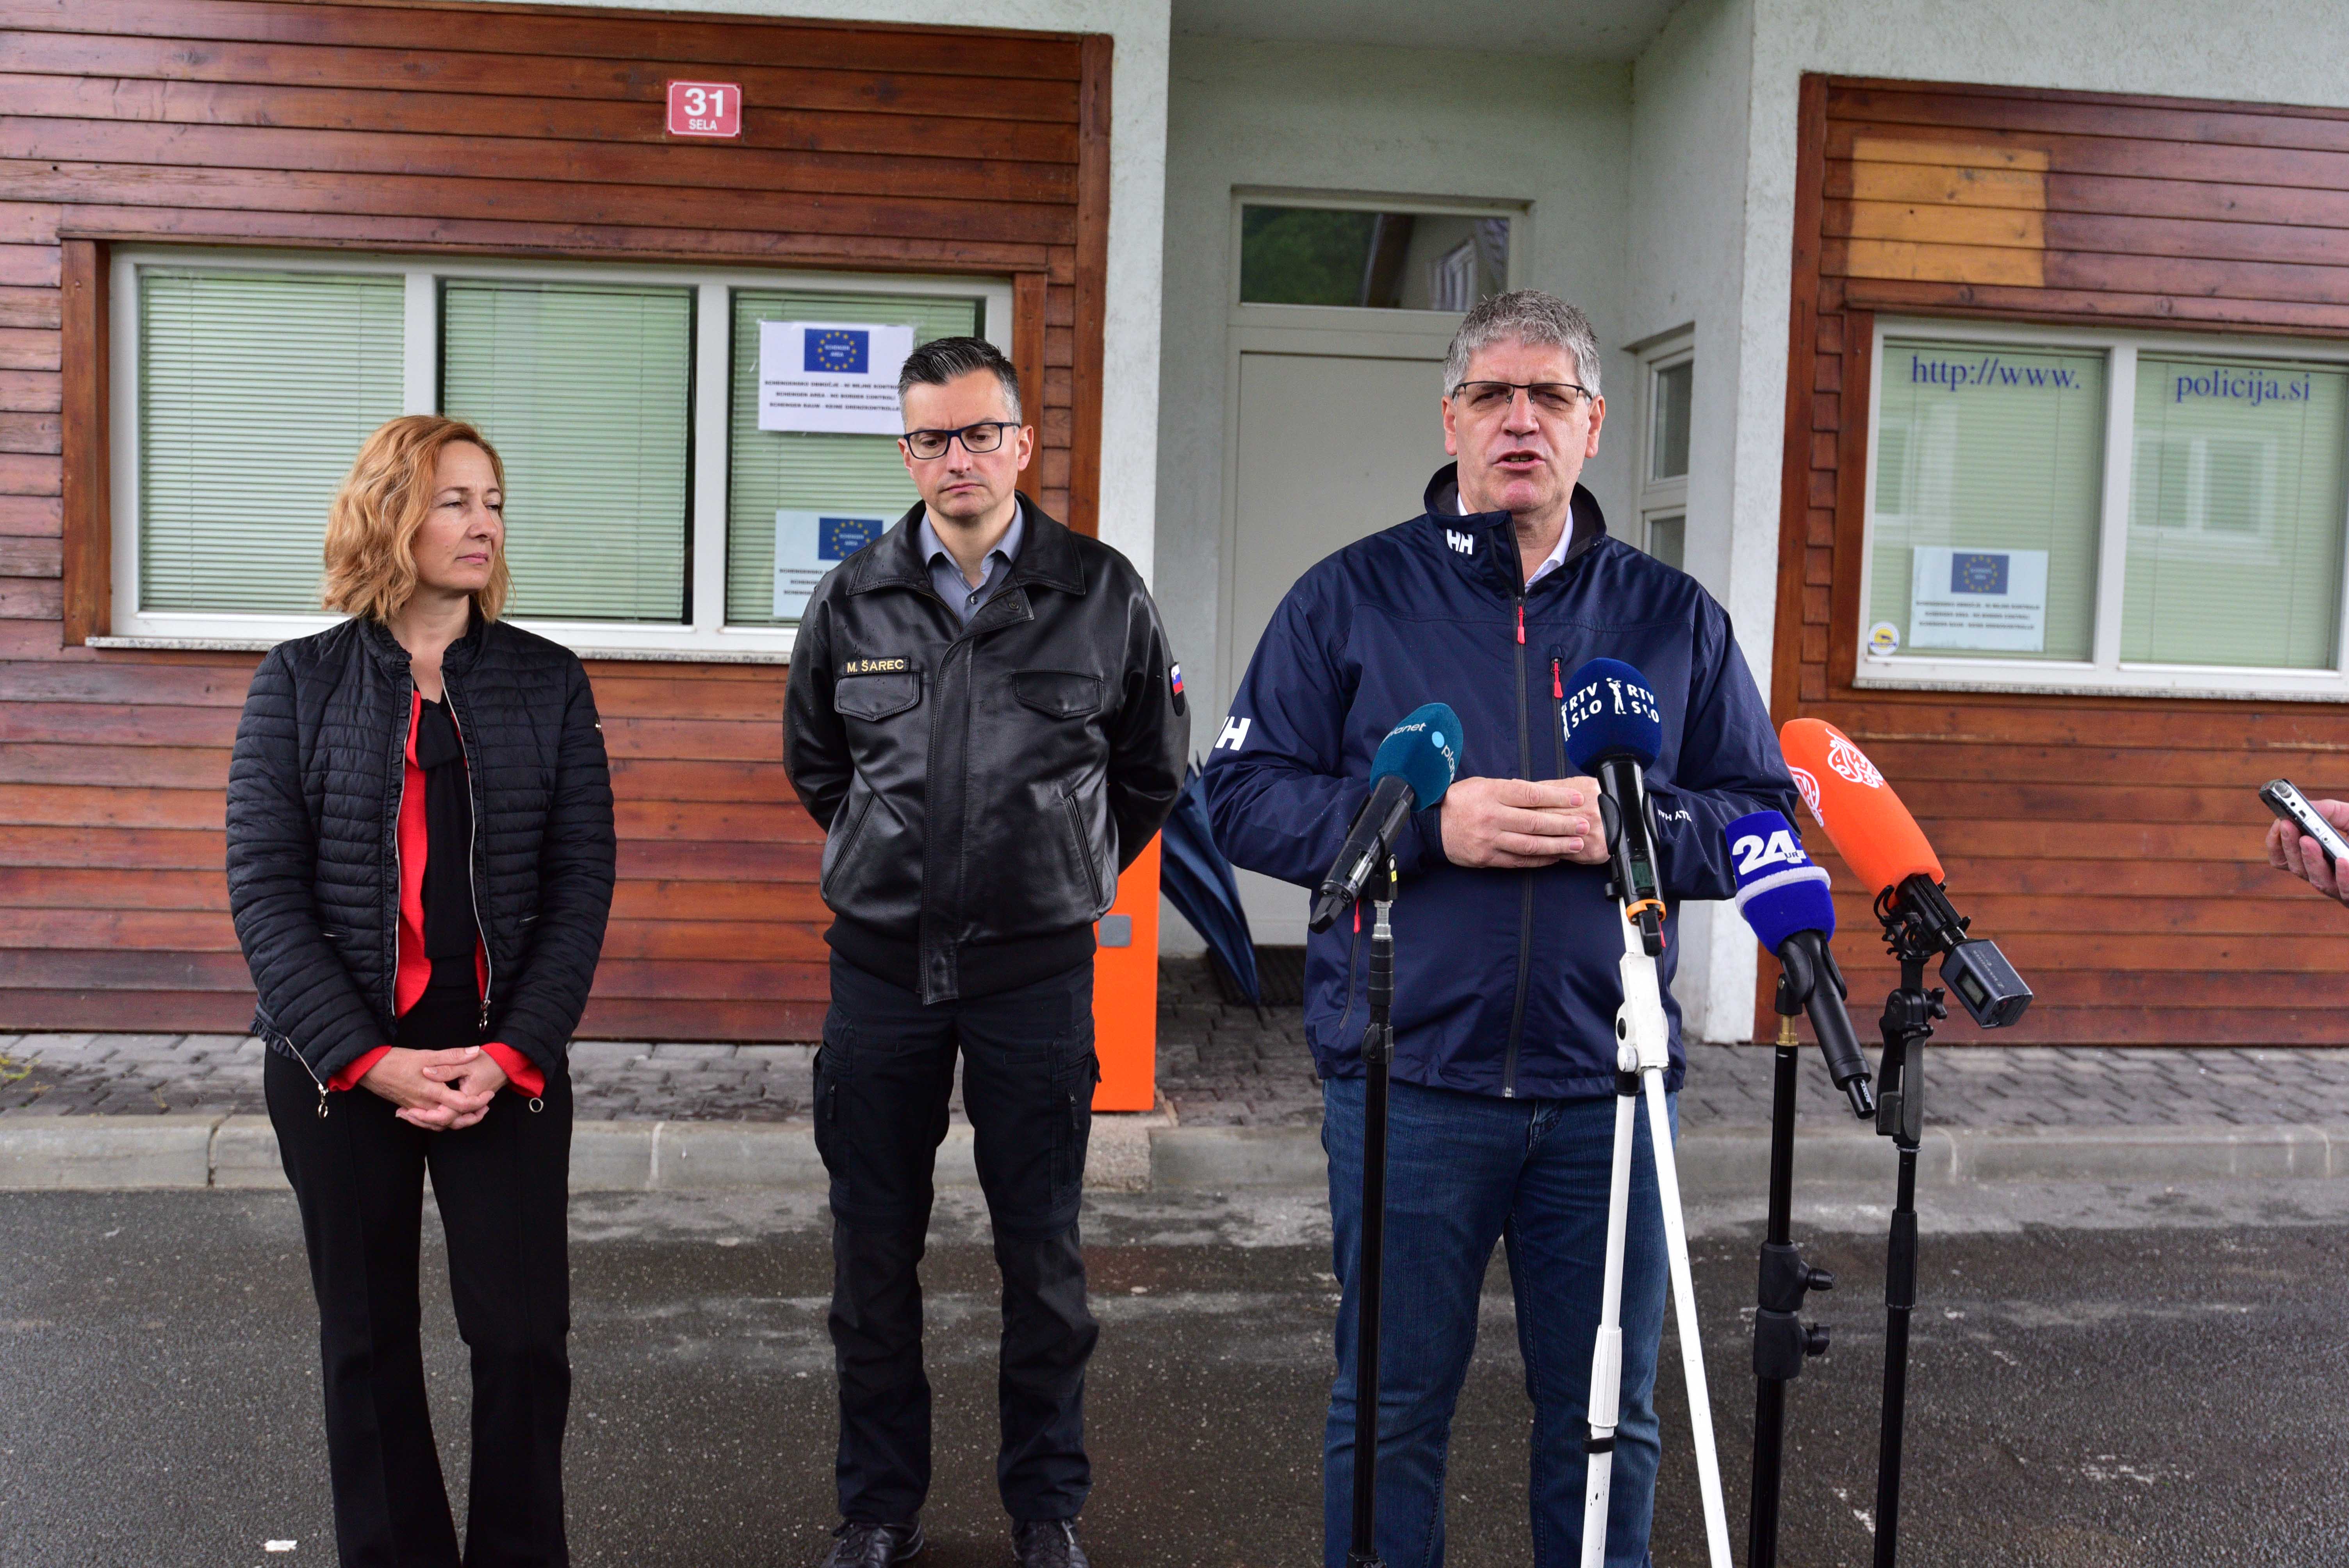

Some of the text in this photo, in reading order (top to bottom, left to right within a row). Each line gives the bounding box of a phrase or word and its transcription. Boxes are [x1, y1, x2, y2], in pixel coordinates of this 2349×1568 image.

[684, 87, 723, 117] 31
[689, 118, 717, 131] SELA
[1912, 354, 2310, 406] http://www. policija.si
[1446, 529, 1473, 555] HH
[847, 659, 904, 673] M. ŠAREC
[1569, 682, 1597, 711] RTV
[1627, 684, 1654, 705] RTV
[1572, 700, 1602, 728] SLO
[1732, 830, 1807, 875] 24
